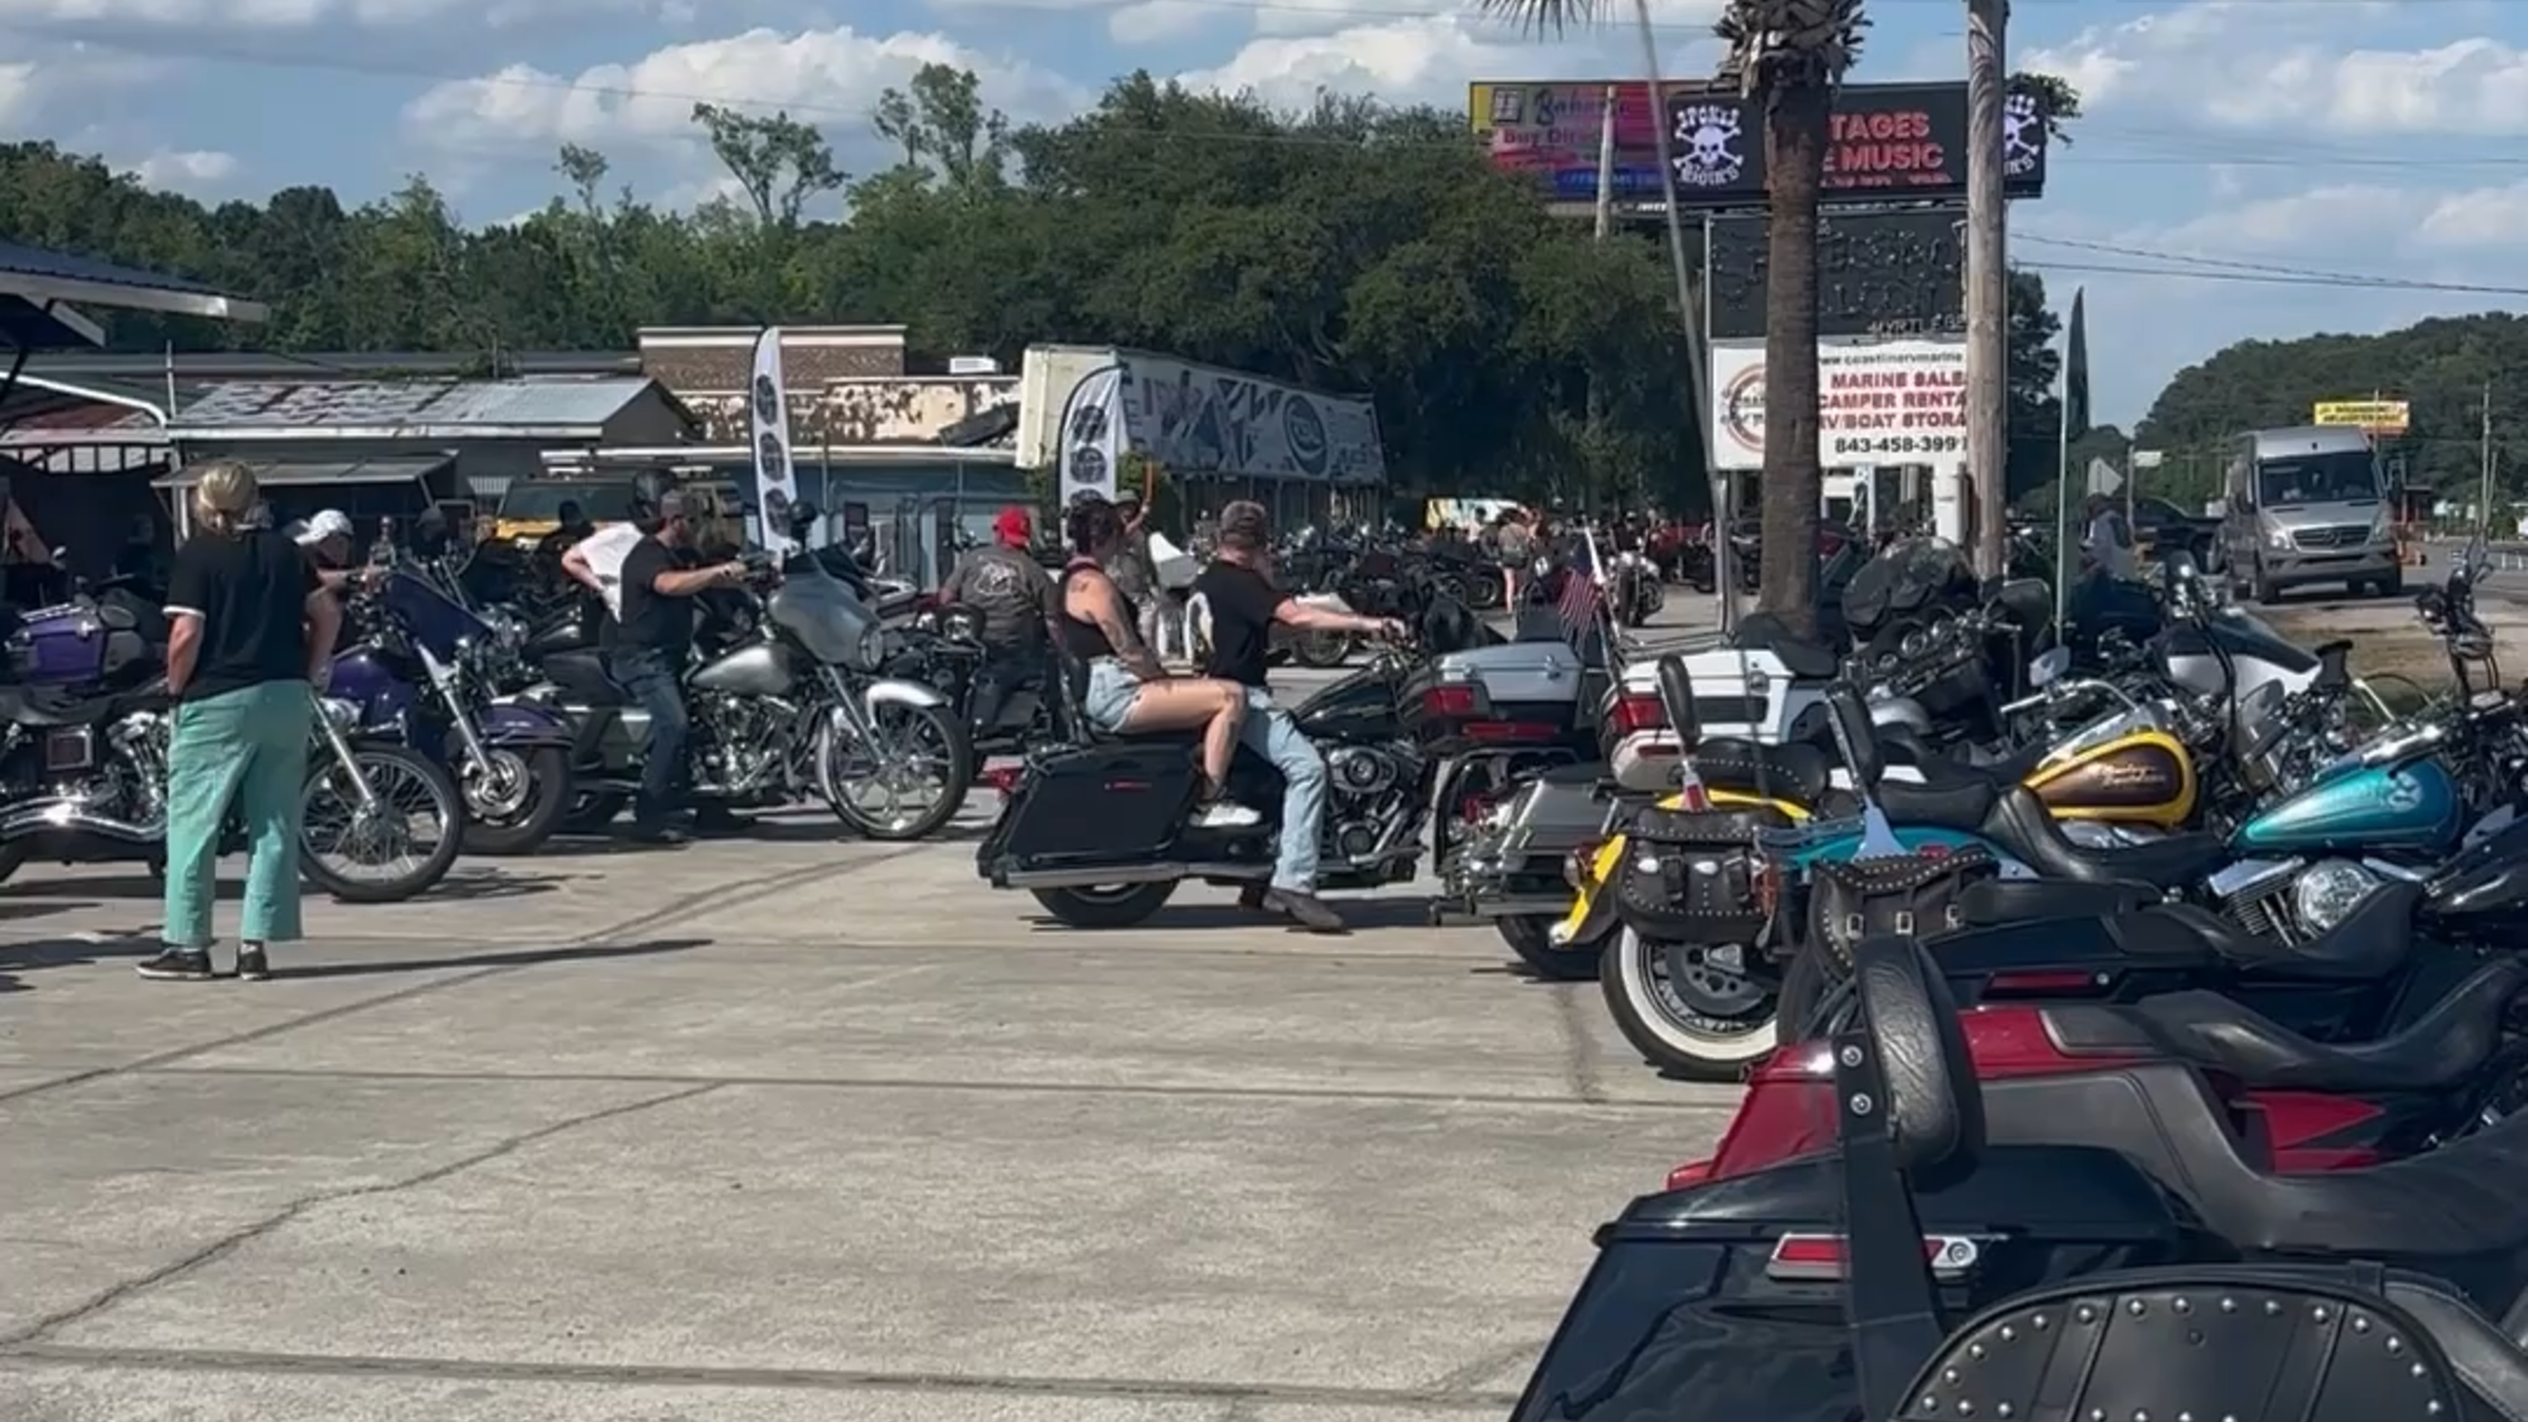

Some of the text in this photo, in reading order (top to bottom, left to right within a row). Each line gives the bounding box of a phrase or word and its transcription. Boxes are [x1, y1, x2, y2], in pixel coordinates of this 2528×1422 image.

[1828, 112, 1930, 140] TAGES
[1840, 143, 1944, 172] MUSIC
[1830, 371, 1967, 389] MARINE SALE
[1819, 391, 1967, 409] CAMPER RENTA
[1902, 412, 1967, 428] STORA
